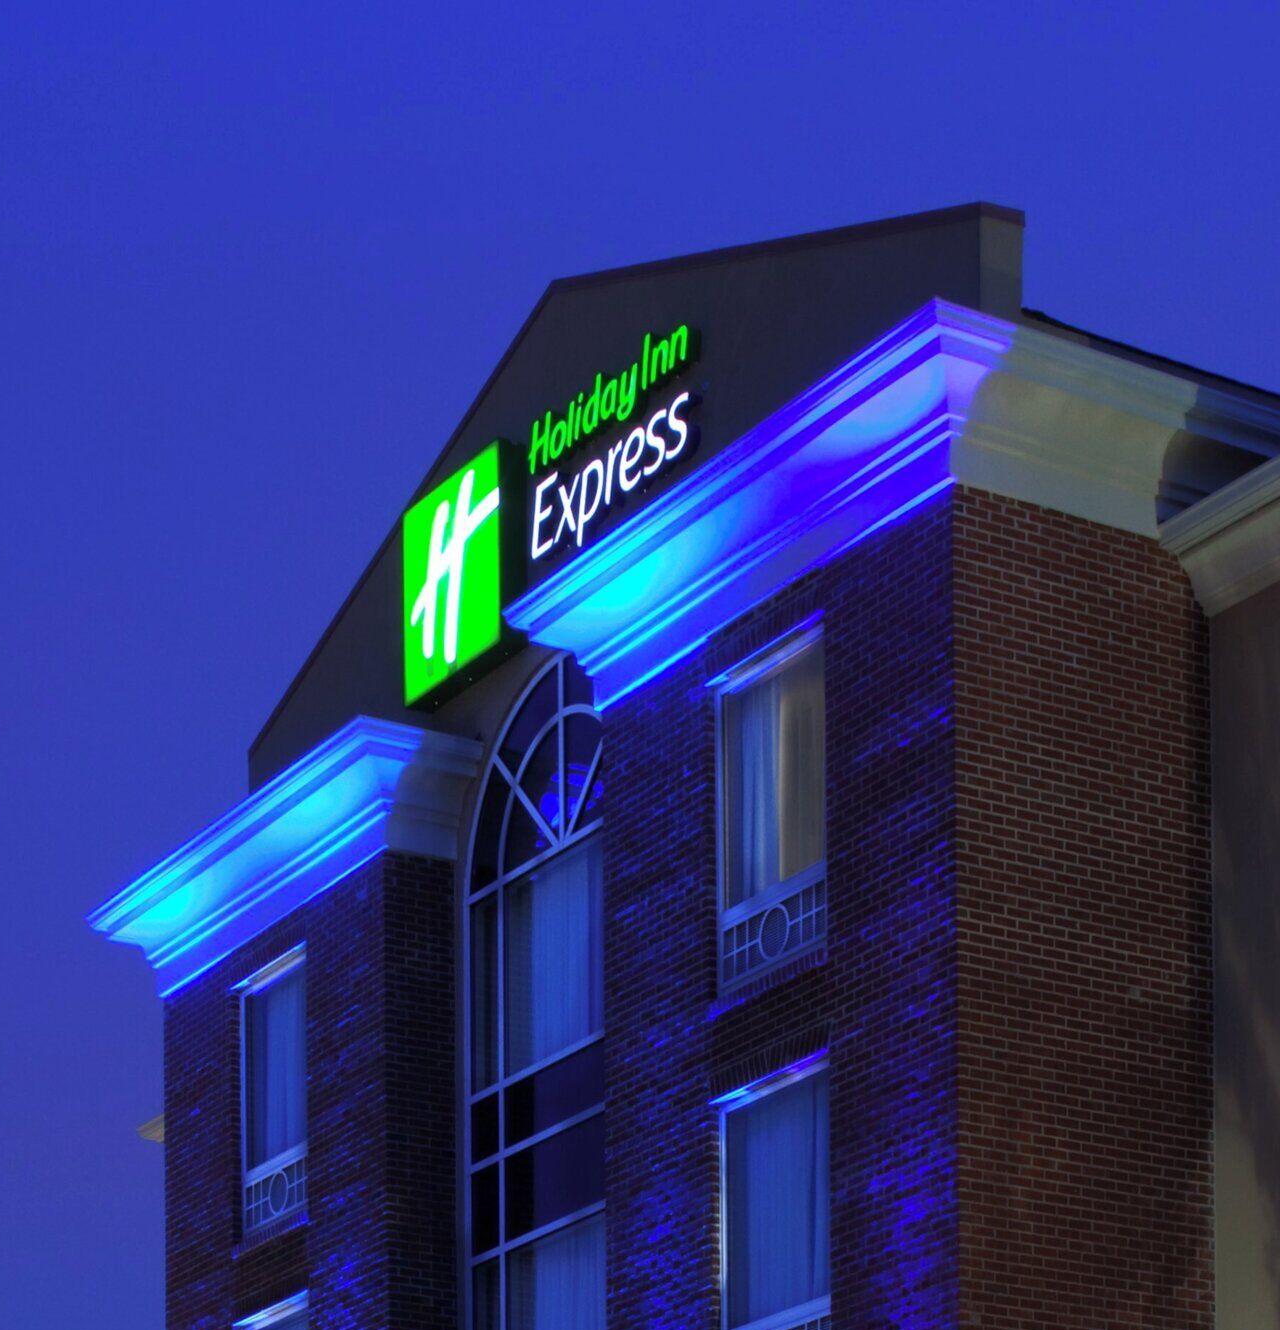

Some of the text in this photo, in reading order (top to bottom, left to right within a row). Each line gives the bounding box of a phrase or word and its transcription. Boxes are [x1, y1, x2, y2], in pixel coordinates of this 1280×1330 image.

[528, 324, 688, 474] Holiday Inn
[531, 391, 690, 560] Express
